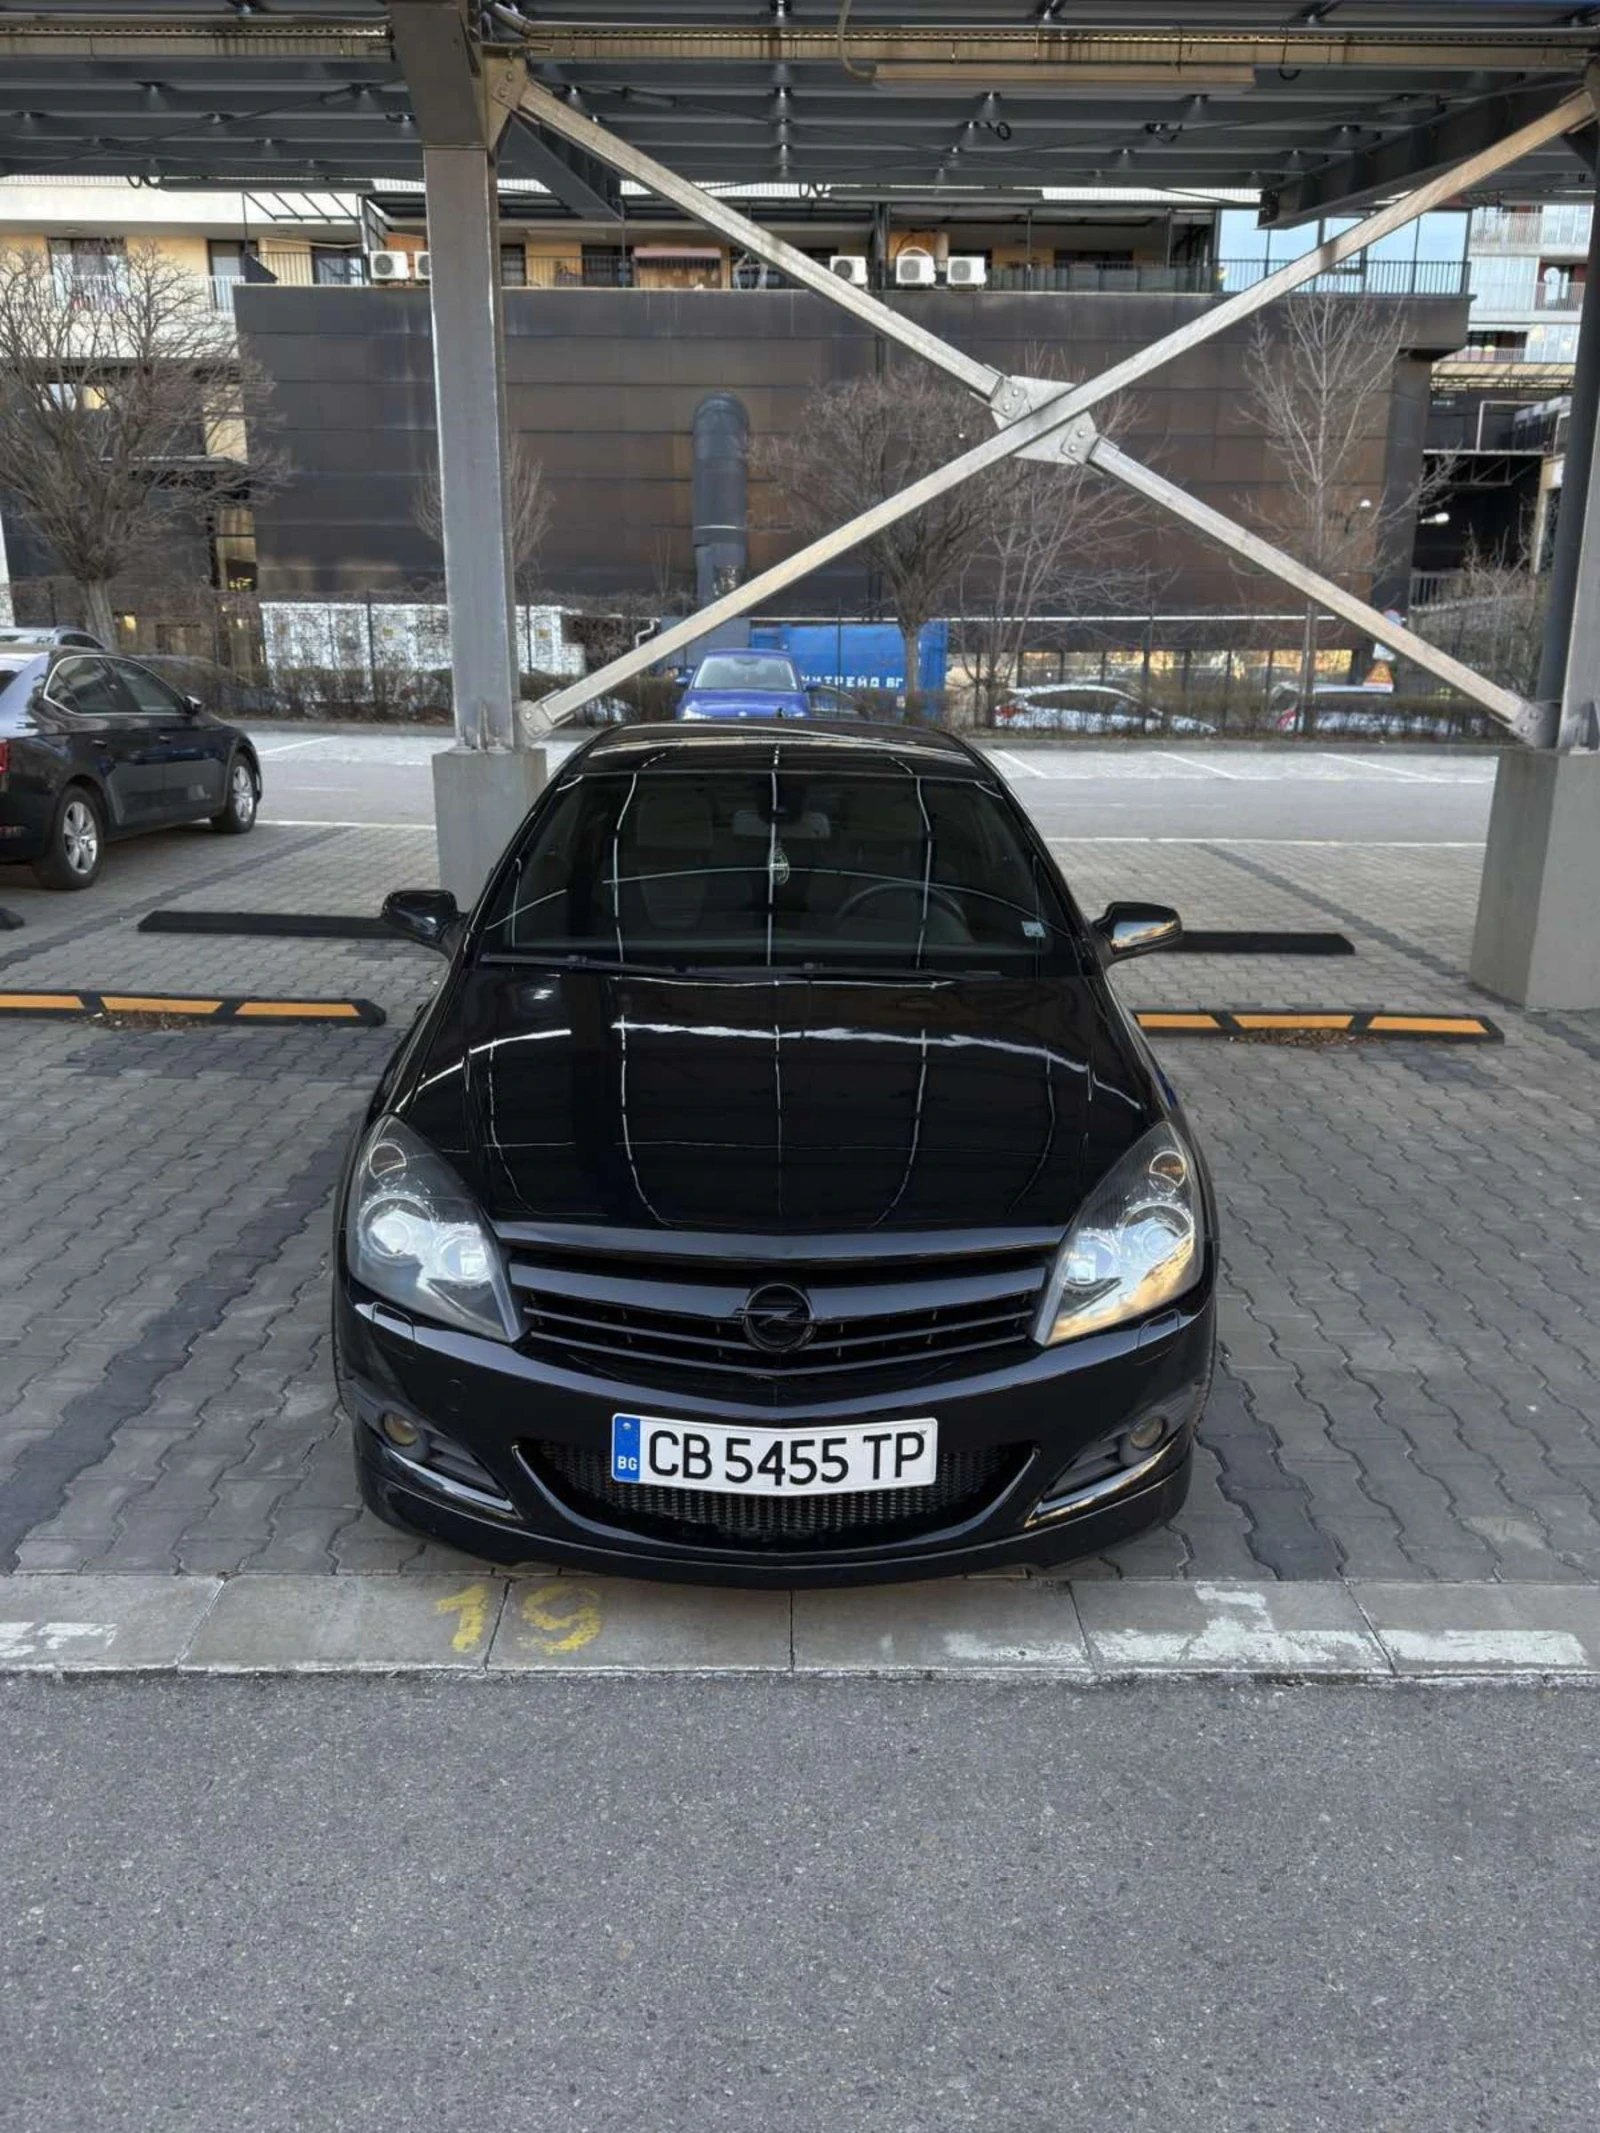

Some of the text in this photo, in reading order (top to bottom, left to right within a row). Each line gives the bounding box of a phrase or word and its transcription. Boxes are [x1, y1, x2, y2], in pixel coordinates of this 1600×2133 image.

[617, 1456, 638, 1471] BG
[649, 1430, 926, 1486] CB 5455 TP
[435, 1583, 602, 1655] 19
